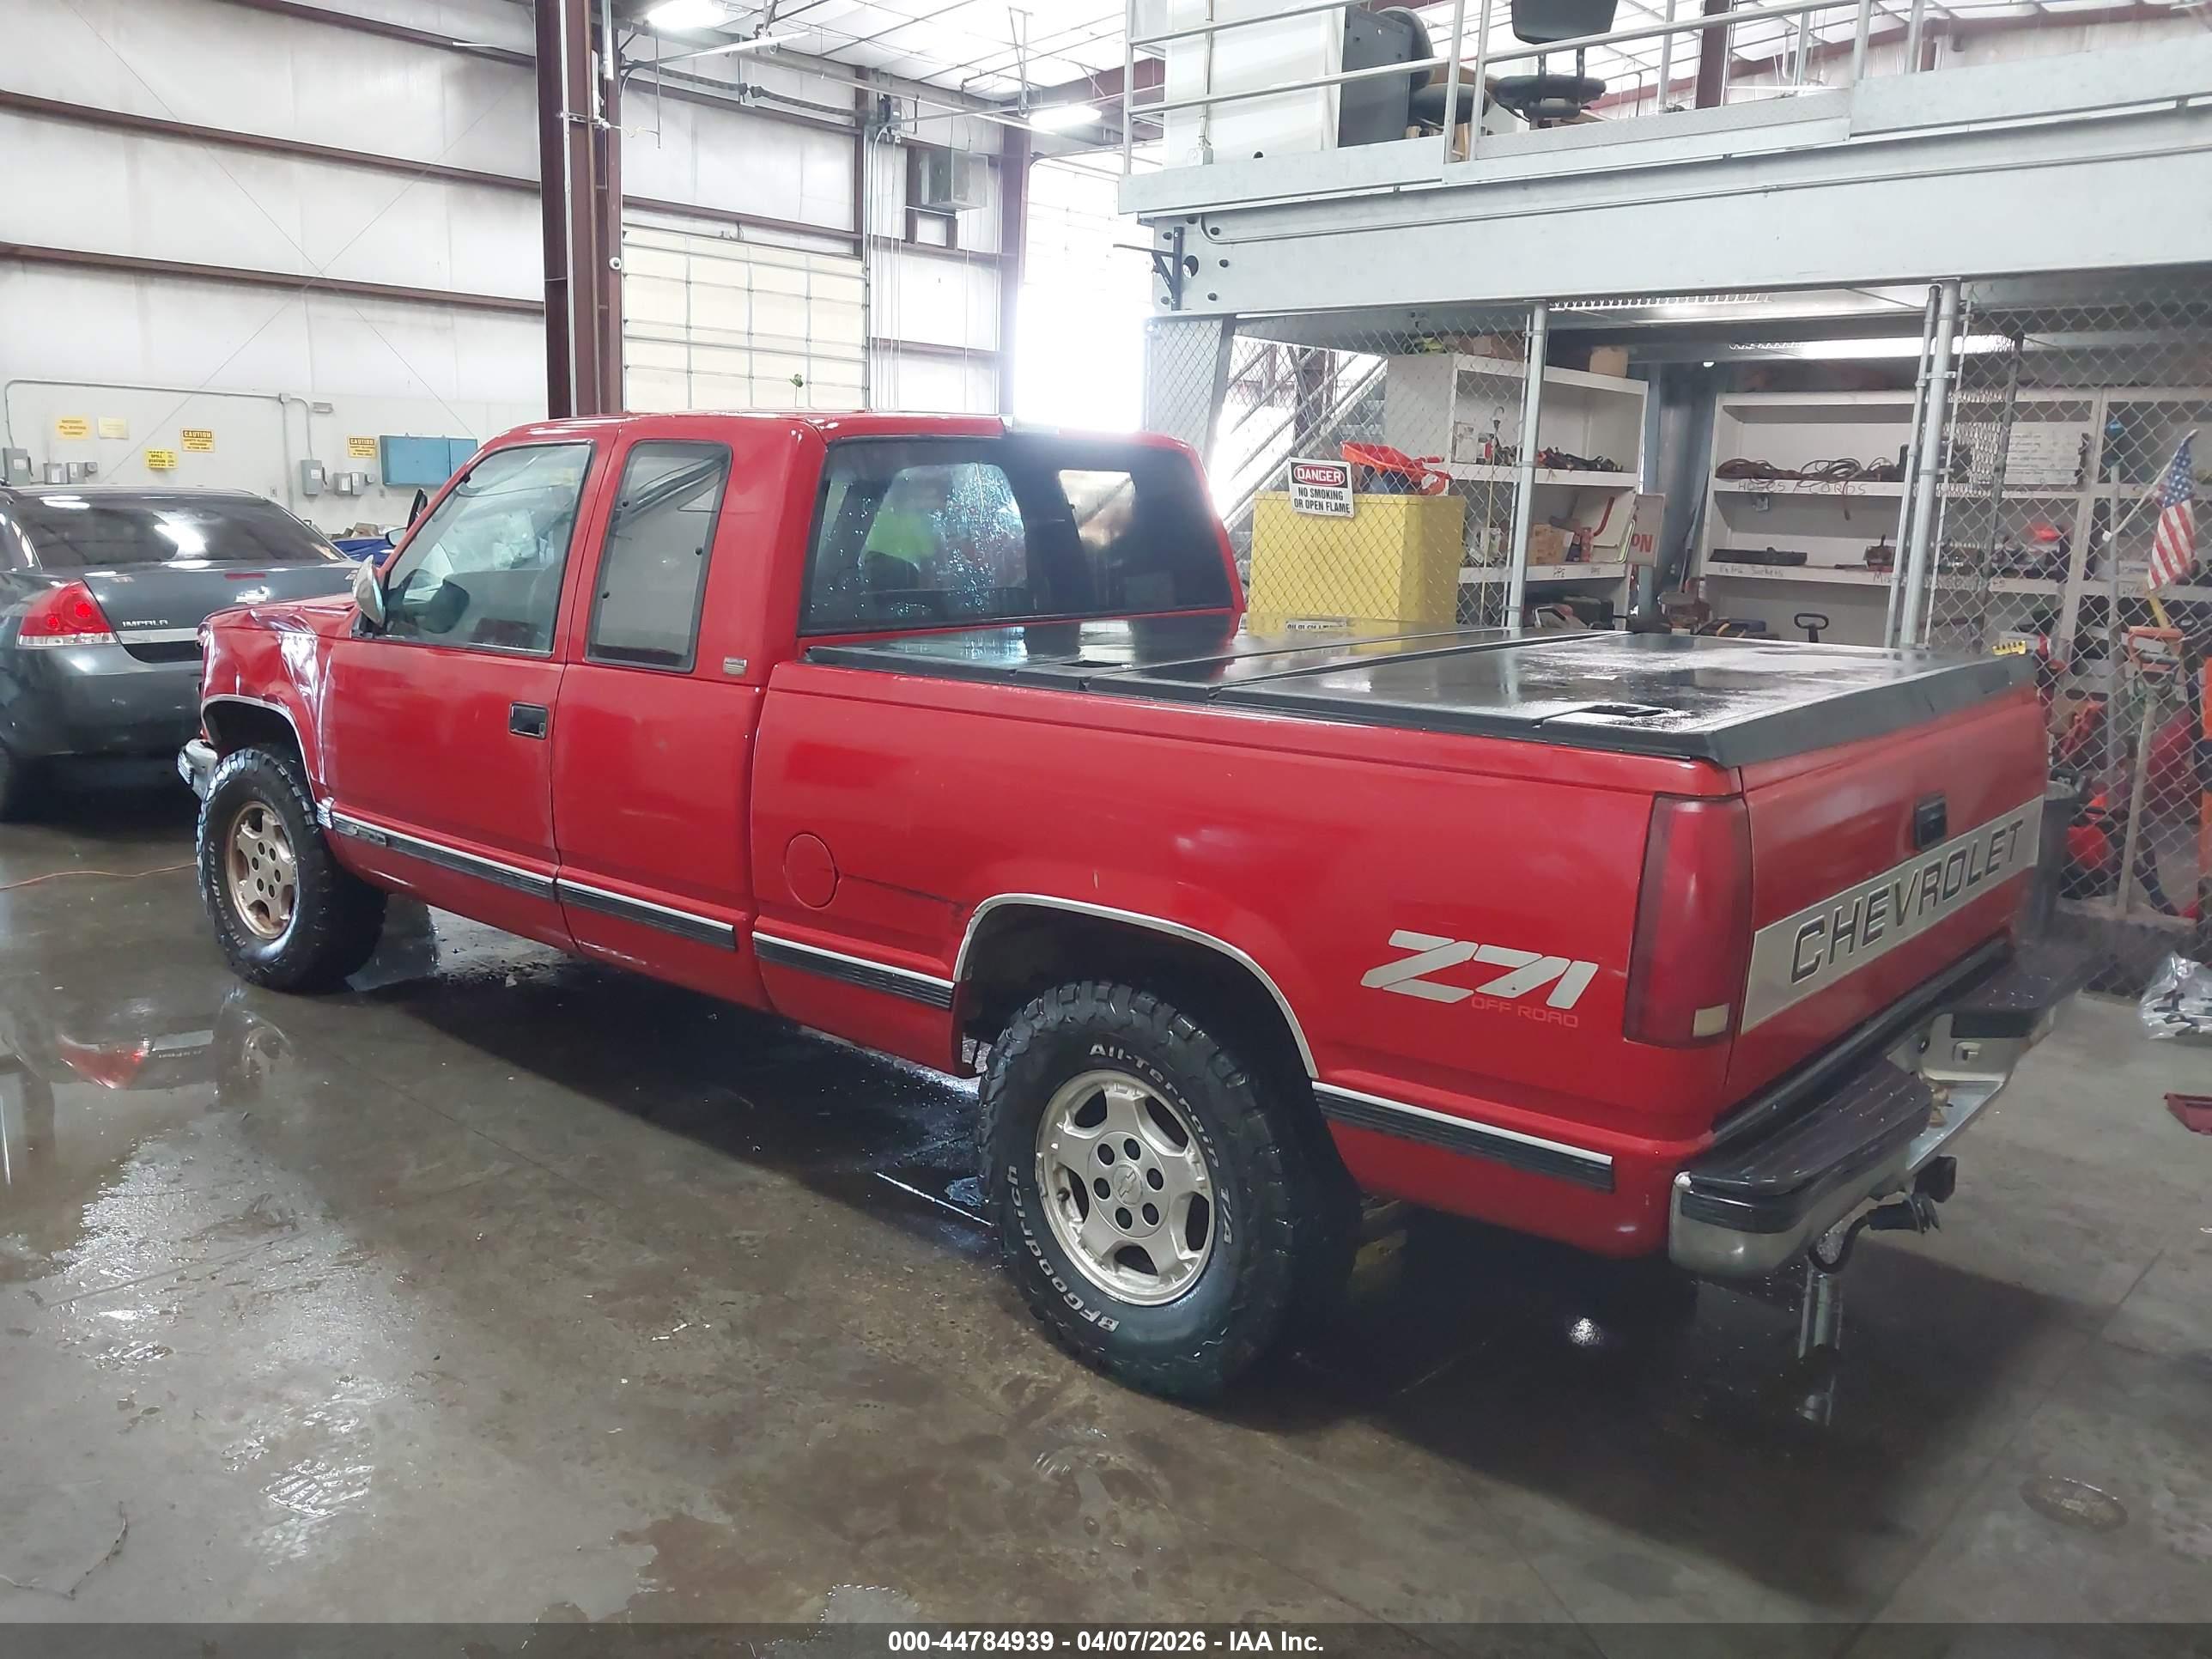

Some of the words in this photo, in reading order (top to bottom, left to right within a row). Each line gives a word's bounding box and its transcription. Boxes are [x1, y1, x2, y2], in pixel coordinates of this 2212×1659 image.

[1297, 467, 1341, 483] DANGER
[1293, 498, 1304, 508] OR
[1305, 500, 1324, 511] OPEN
[1326, 501, 1351, 514] FLAME
[1297, 487, 1309, 497] NO
[1310, 488, 1344, 501] SMOKING
[122, 619, 168, 628] IMPALA
[1791, 819, 2024, 984] CHEVROLET
[1360, 928, 1600, 1010] Z71
[1471, 996, 1512, 1013] OFF
[1517, 1005, 1578, 1028] ROAD
[1090, 1044, 1219, 1168] All-Terrain
